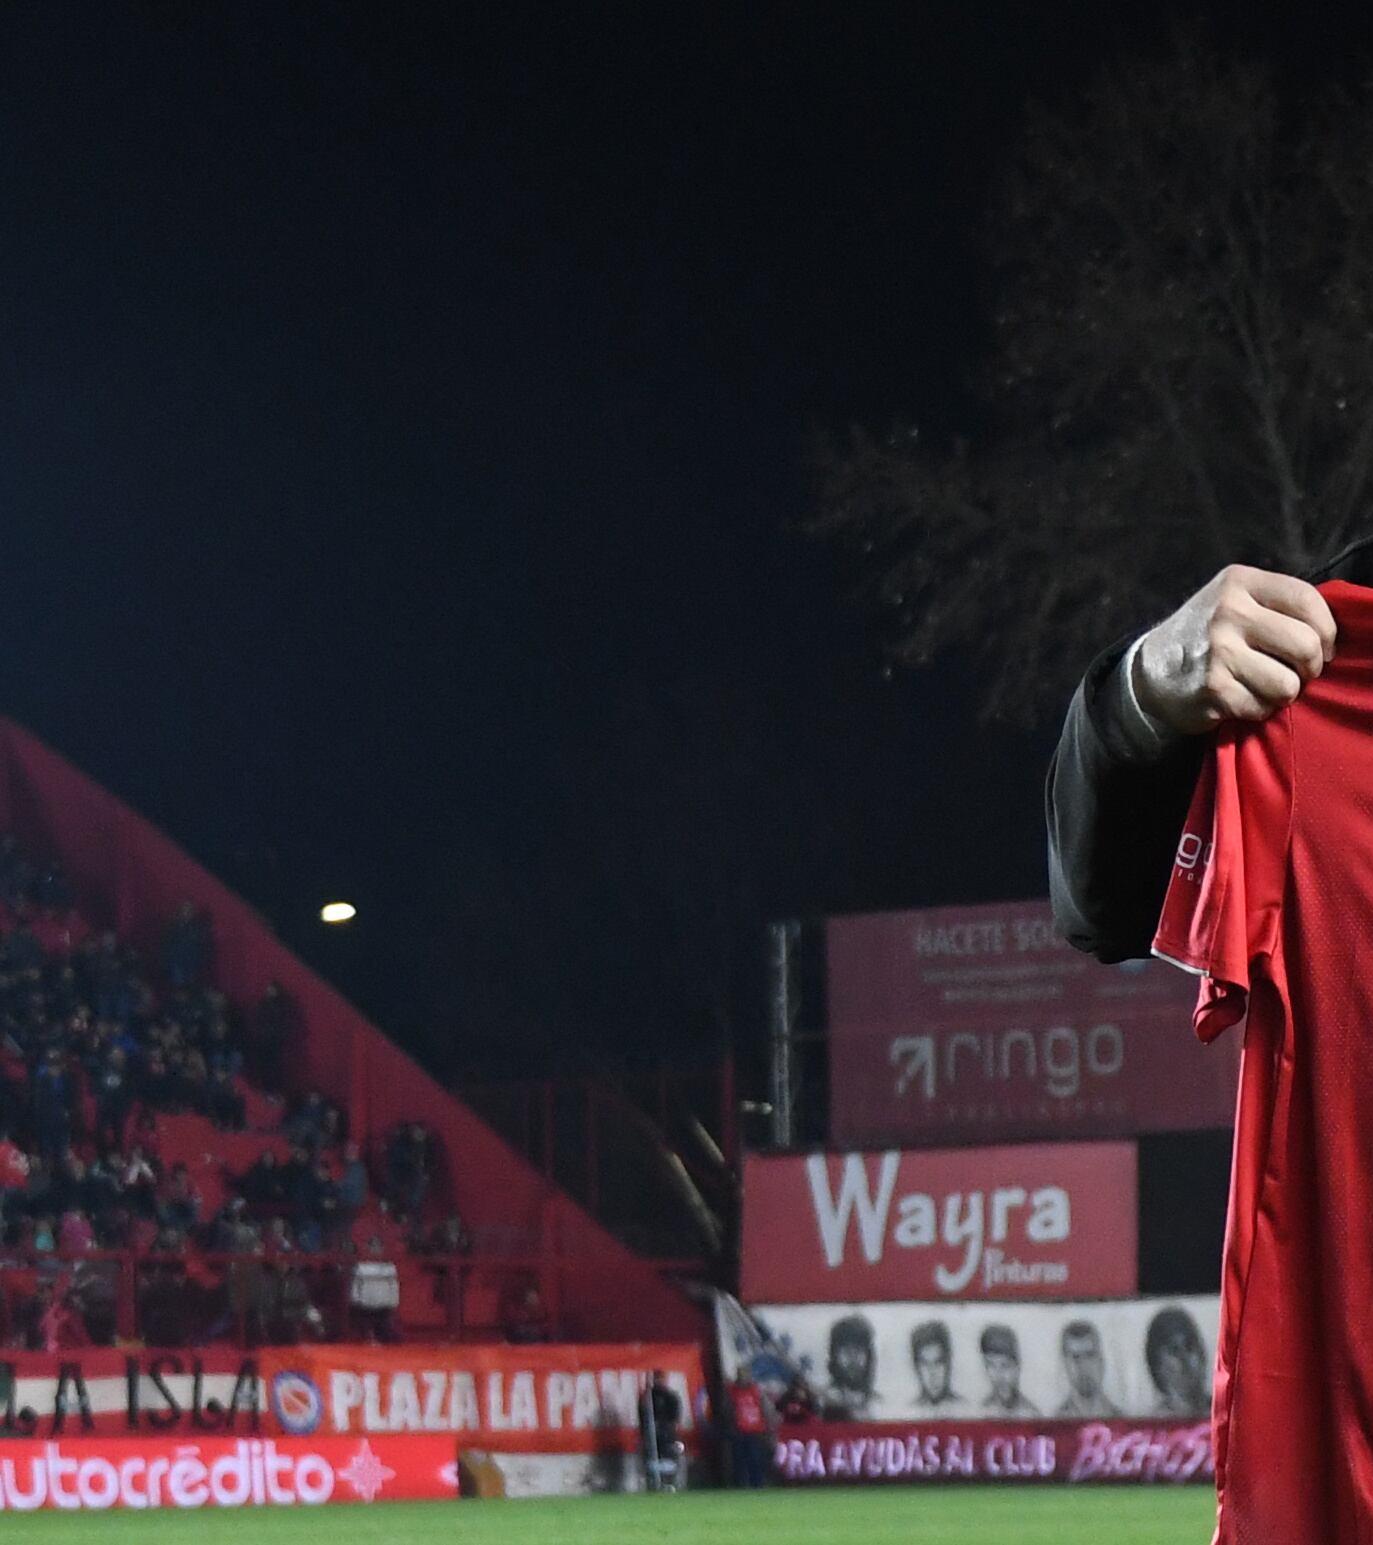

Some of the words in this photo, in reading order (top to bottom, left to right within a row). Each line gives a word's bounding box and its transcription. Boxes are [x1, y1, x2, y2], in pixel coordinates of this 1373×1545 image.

[946, 1024, 1124, 1097] ringo
[806, 1150, 1072, 1293] Wayra
[331, 1369, 480, 1433] PLAZA
[489, 1369, 538, 1430] LA
[0, 1437, 335, 1510] utocrédito
[984, 1434, 1057, 1478] CLUB
